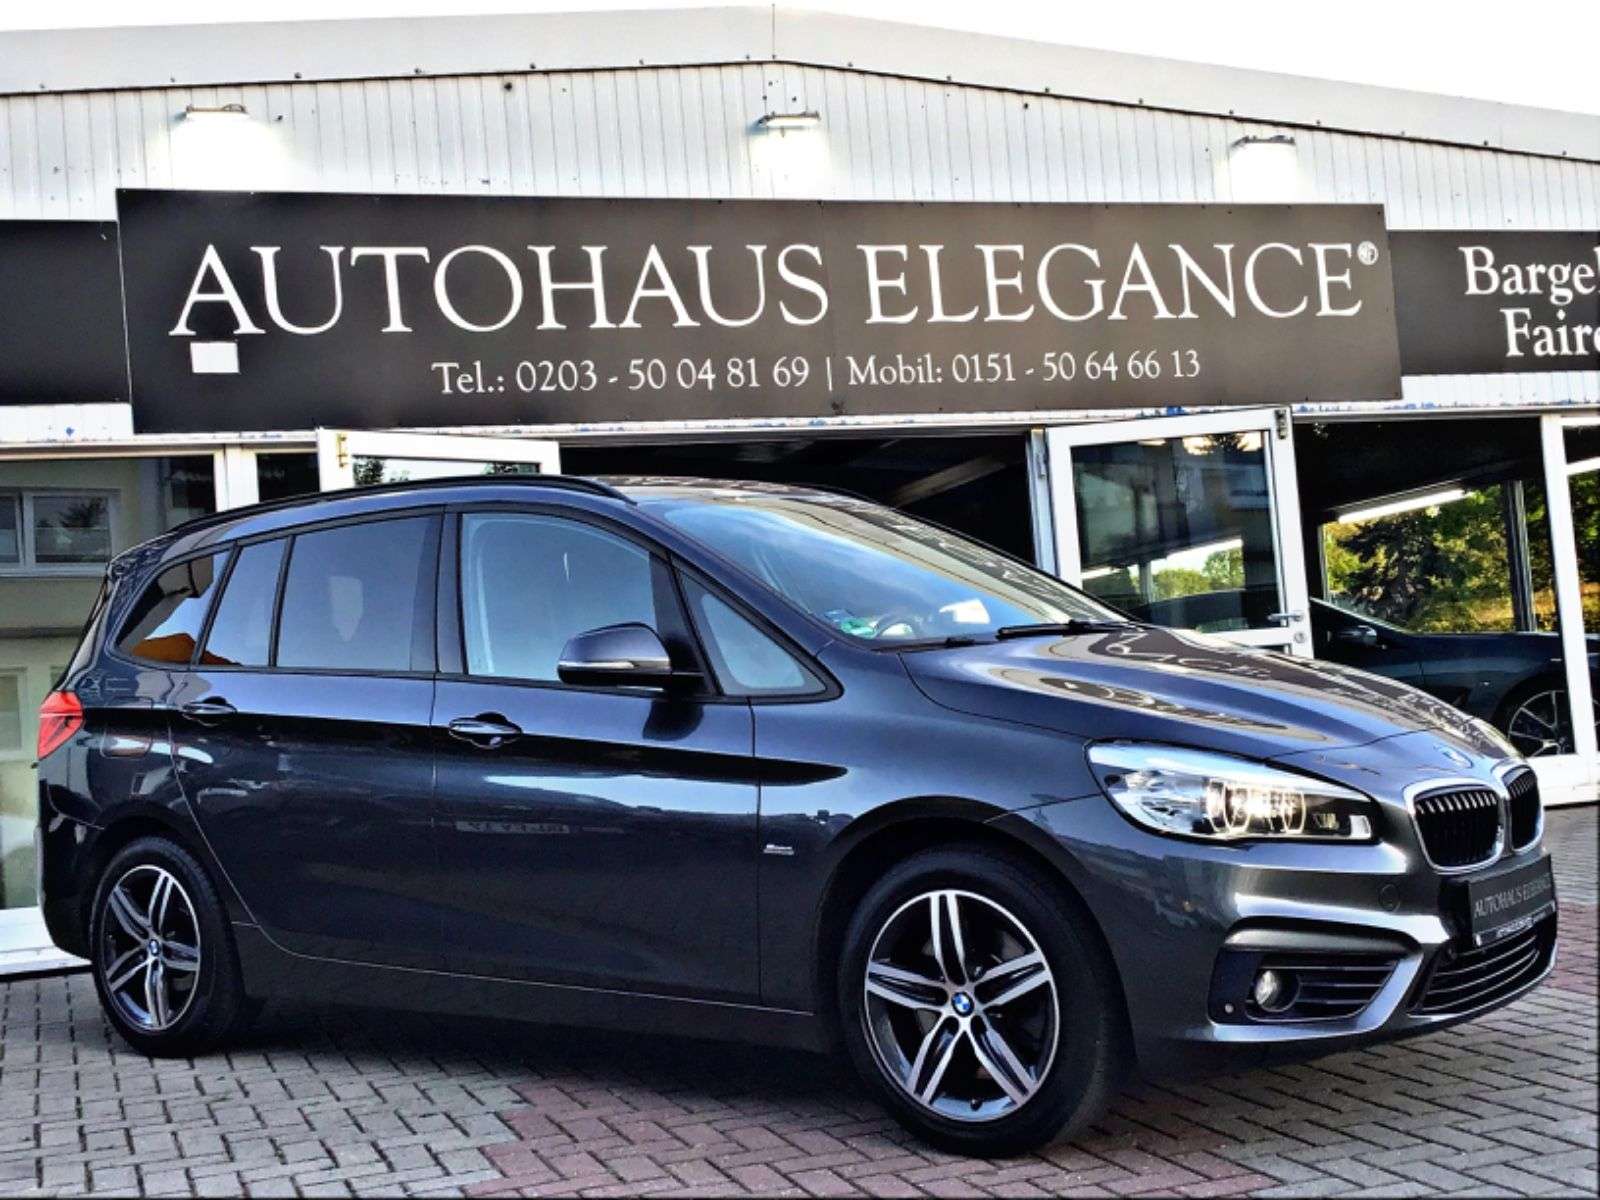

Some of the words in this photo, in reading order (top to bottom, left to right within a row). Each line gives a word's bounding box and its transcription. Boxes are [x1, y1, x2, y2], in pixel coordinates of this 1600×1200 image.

[168, 243, 829, 336] AUTOHAUS
[431, 360, 505, 394] Tel.:
[515, 359, 598, 392] 0203
[628, 358, 667, 391] 50
[676, 358, 717, 391] 04
[726, 357, 761, 389] 81
[772, 355, 810, 388] 69
[845, 351, 944, 386] Mobil:
[951, 351, 1017, 384] 0151
[1042, 351, 1077, 382] 50
[1084, 350, 1119, 382] 64
[1126, 348, 1162, 380] 66
[1170, 347, 1201, 378] 13
